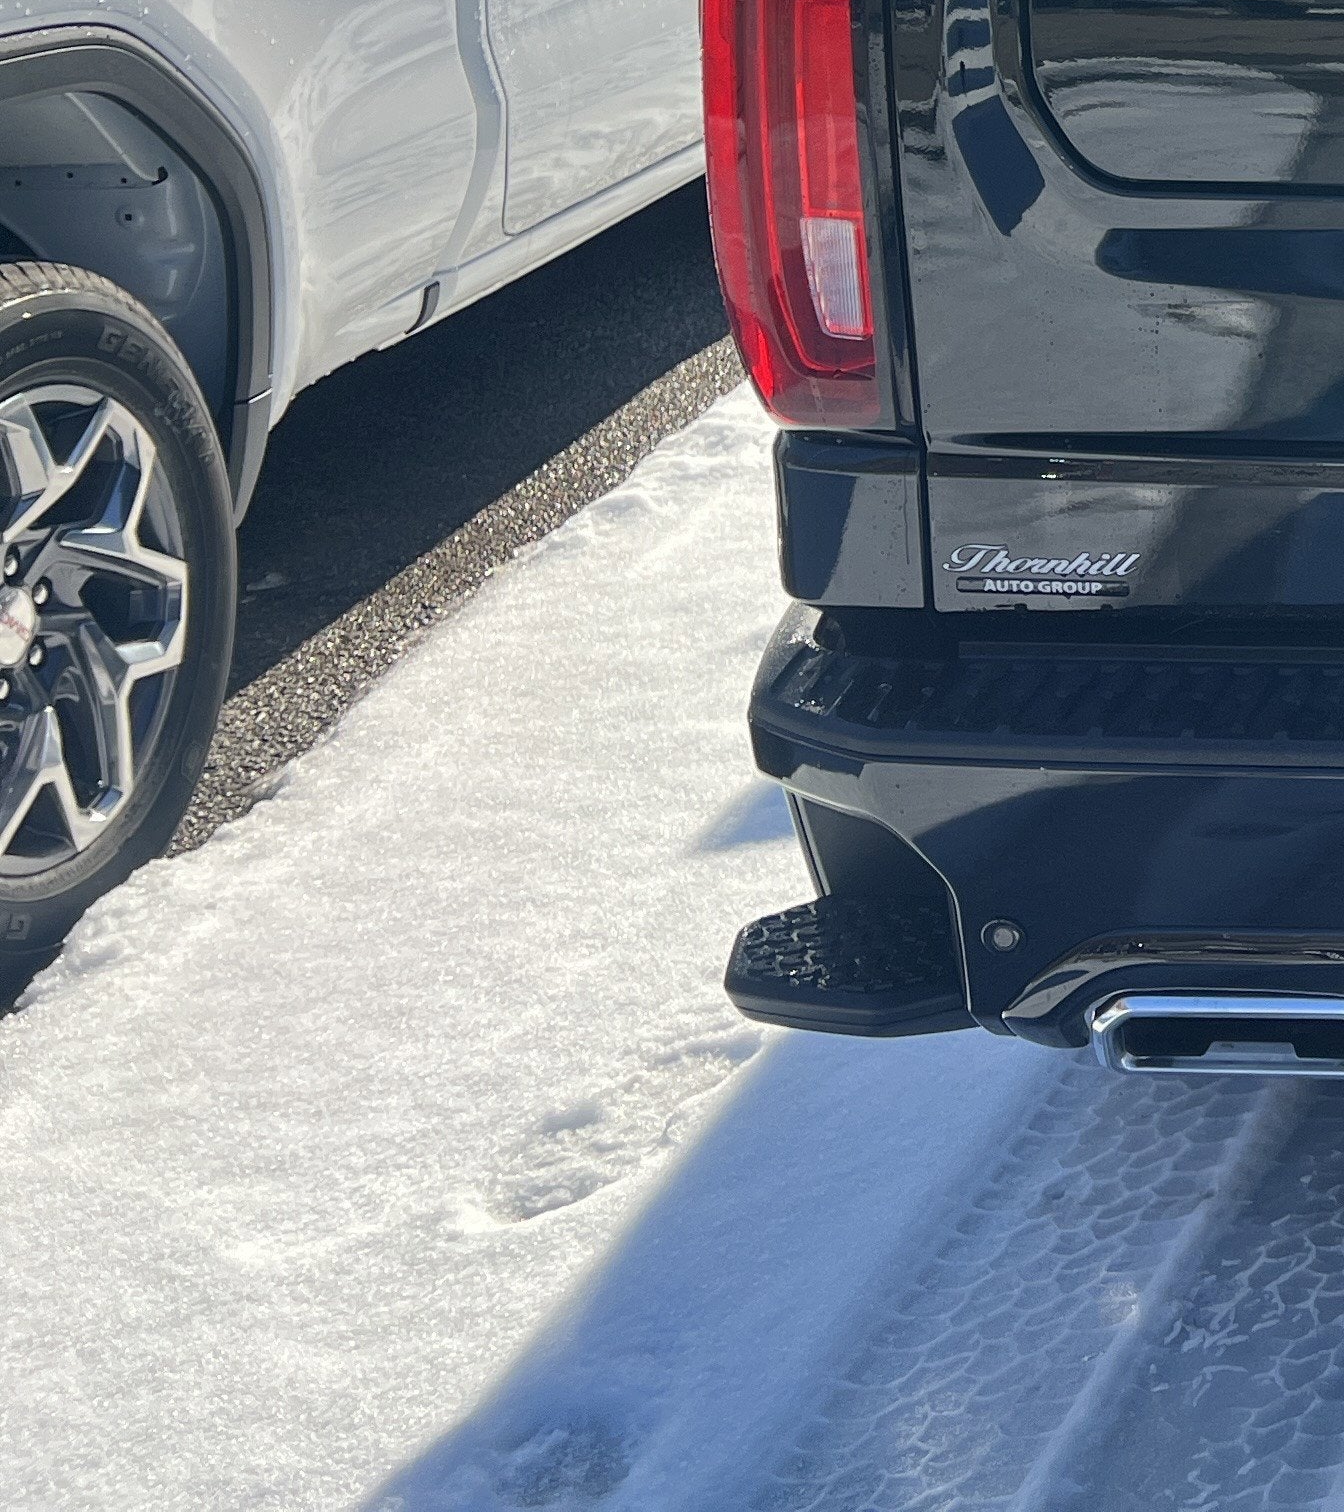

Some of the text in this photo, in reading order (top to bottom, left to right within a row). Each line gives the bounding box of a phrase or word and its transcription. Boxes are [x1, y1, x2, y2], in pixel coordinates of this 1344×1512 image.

[942, 543, 1141, 577] Thornhill
[983, 578, 1103, 595] AUTO GROUP
